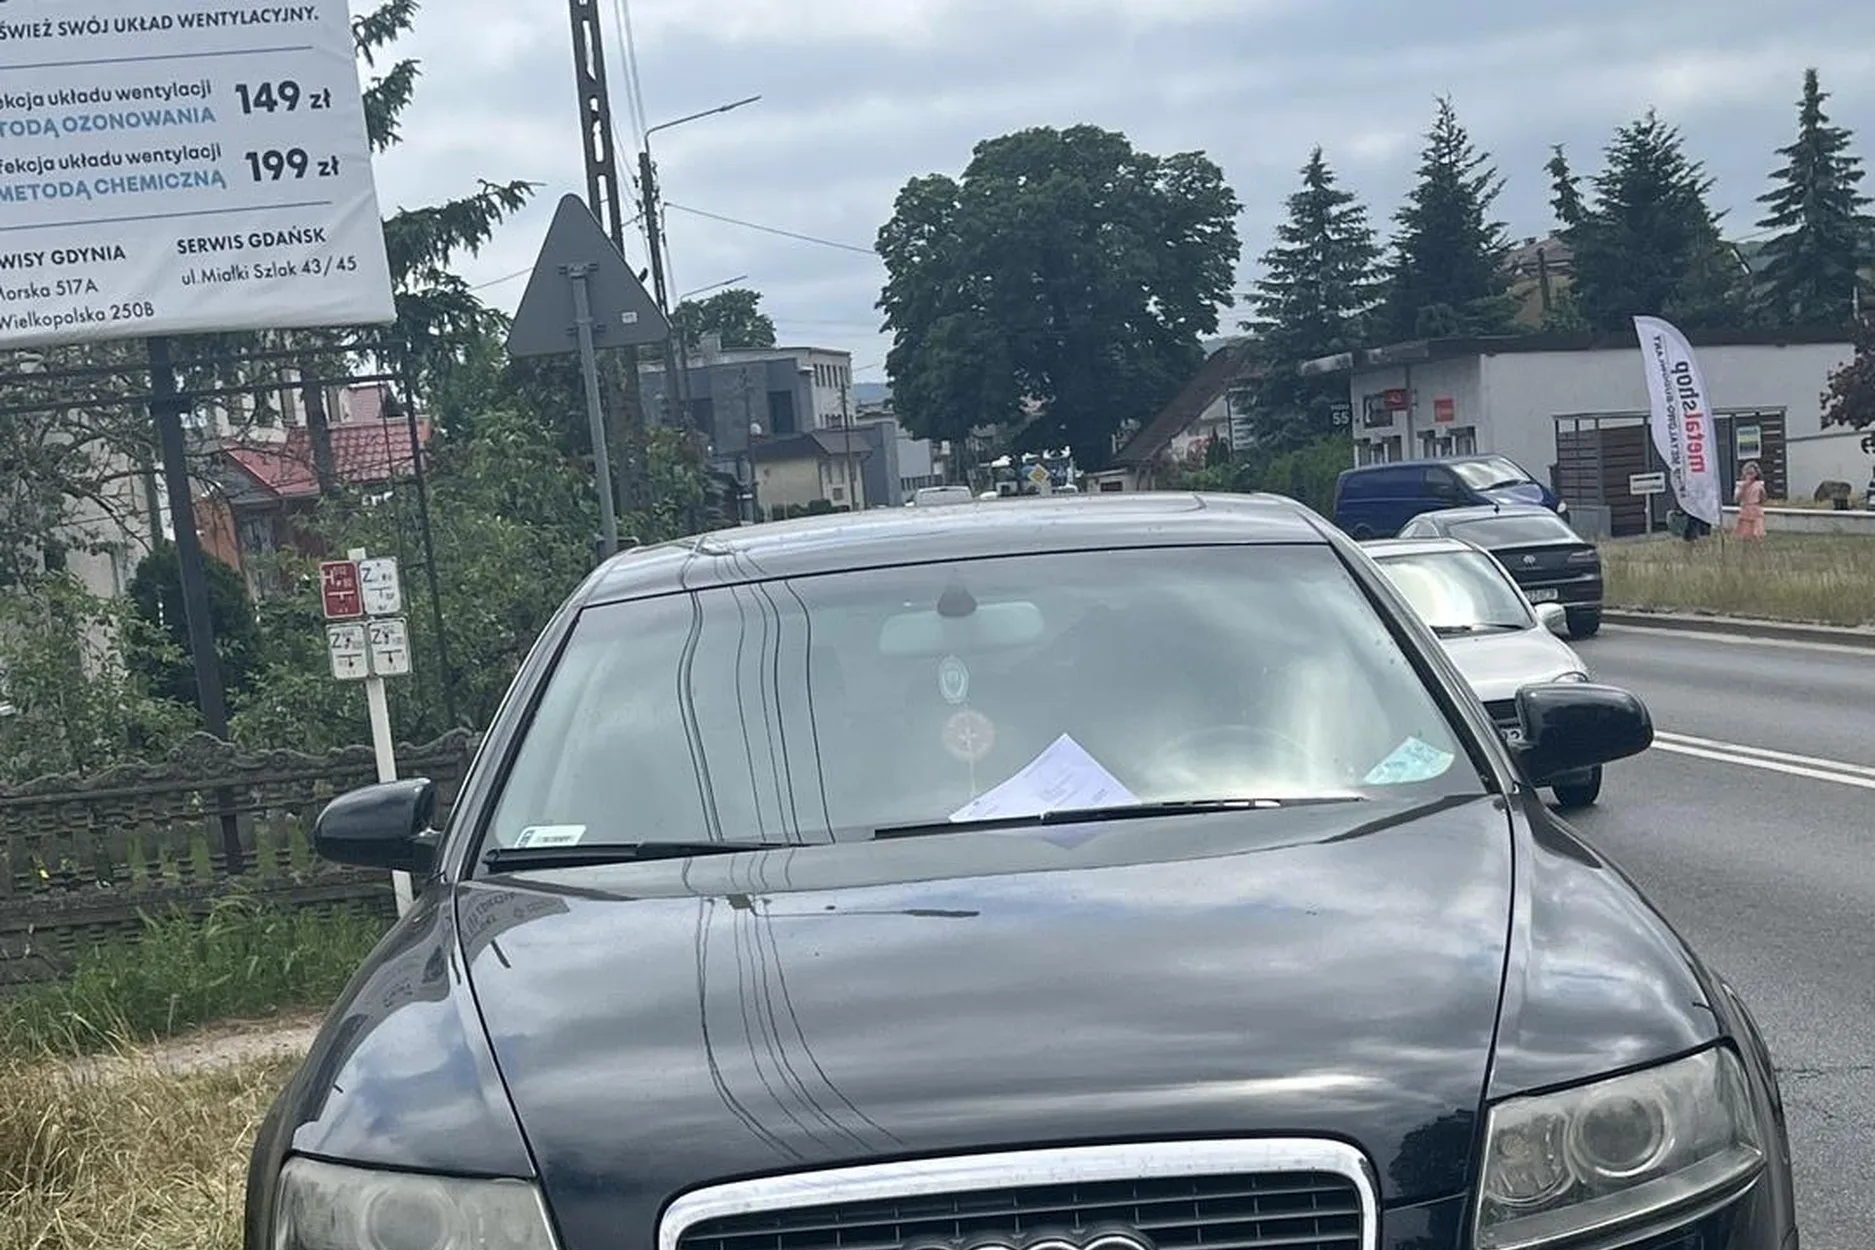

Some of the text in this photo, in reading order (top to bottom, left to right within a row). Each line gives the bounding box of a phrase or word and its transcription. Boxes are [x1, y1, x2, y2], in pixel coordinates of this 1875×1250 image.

[58, 15, 109, 36] SWÓJ
[114, 15, 173, 33] UKŁAD
[178, 6, 319, 28] WENTYLACYJNY.
[48, 87, 112, 106] układu
[115, 79, 212, 101] wentylacji
[235, 80, 331, 114] 149 zł
[62, 106, 216, 133] OZONOWANIA
[0, 143, 222, 176] ekcja układu wentylacji
[245, 148, 340, 181] 199 zł
[0, 169, 227, 202] METODĄ CHEMICZNĄ
[177, 225, 326, 254] SERWIS GDAŃSK
[0, 245, 126, 269] WISY GDYNIA
[253, 261, 297, 279] Szlak
[0, 301, 155, 330] Wielkopolska 250B
